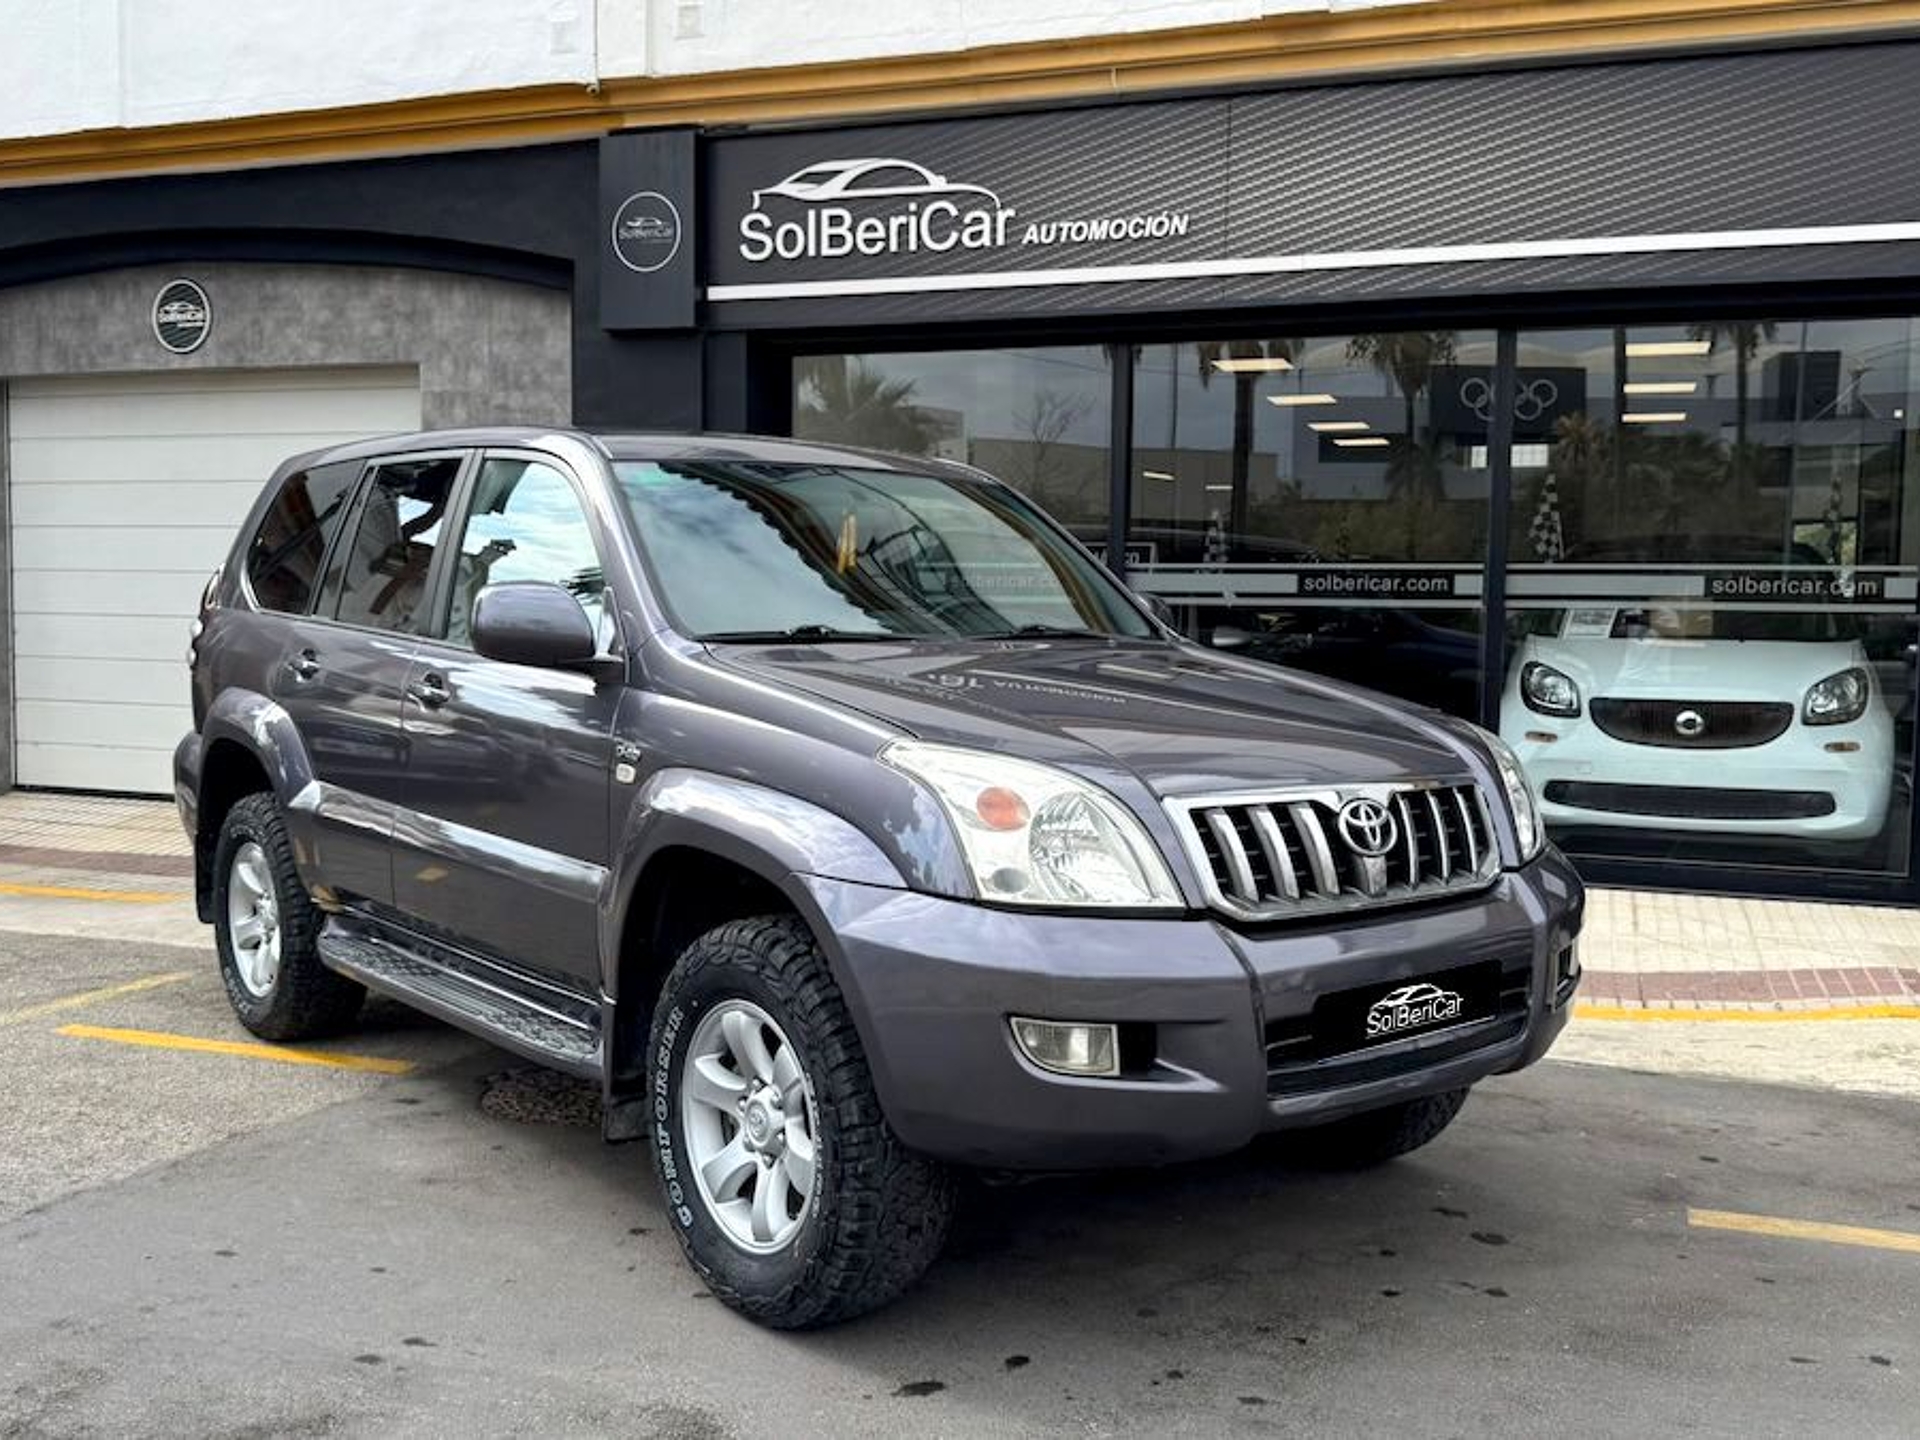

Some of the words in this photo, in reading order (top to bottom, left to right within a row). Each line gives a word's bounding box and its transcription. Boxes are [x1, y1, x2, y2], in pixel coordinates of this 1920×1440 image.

[739, 200, 1016, 262] SolBeriCar
[1021, 211, 1189, 244] AUTOMOCIÓN
[1304, 573, 1448, 592] solbericar.com
[1366, 997, 1464, 1035] SolBeriCar
